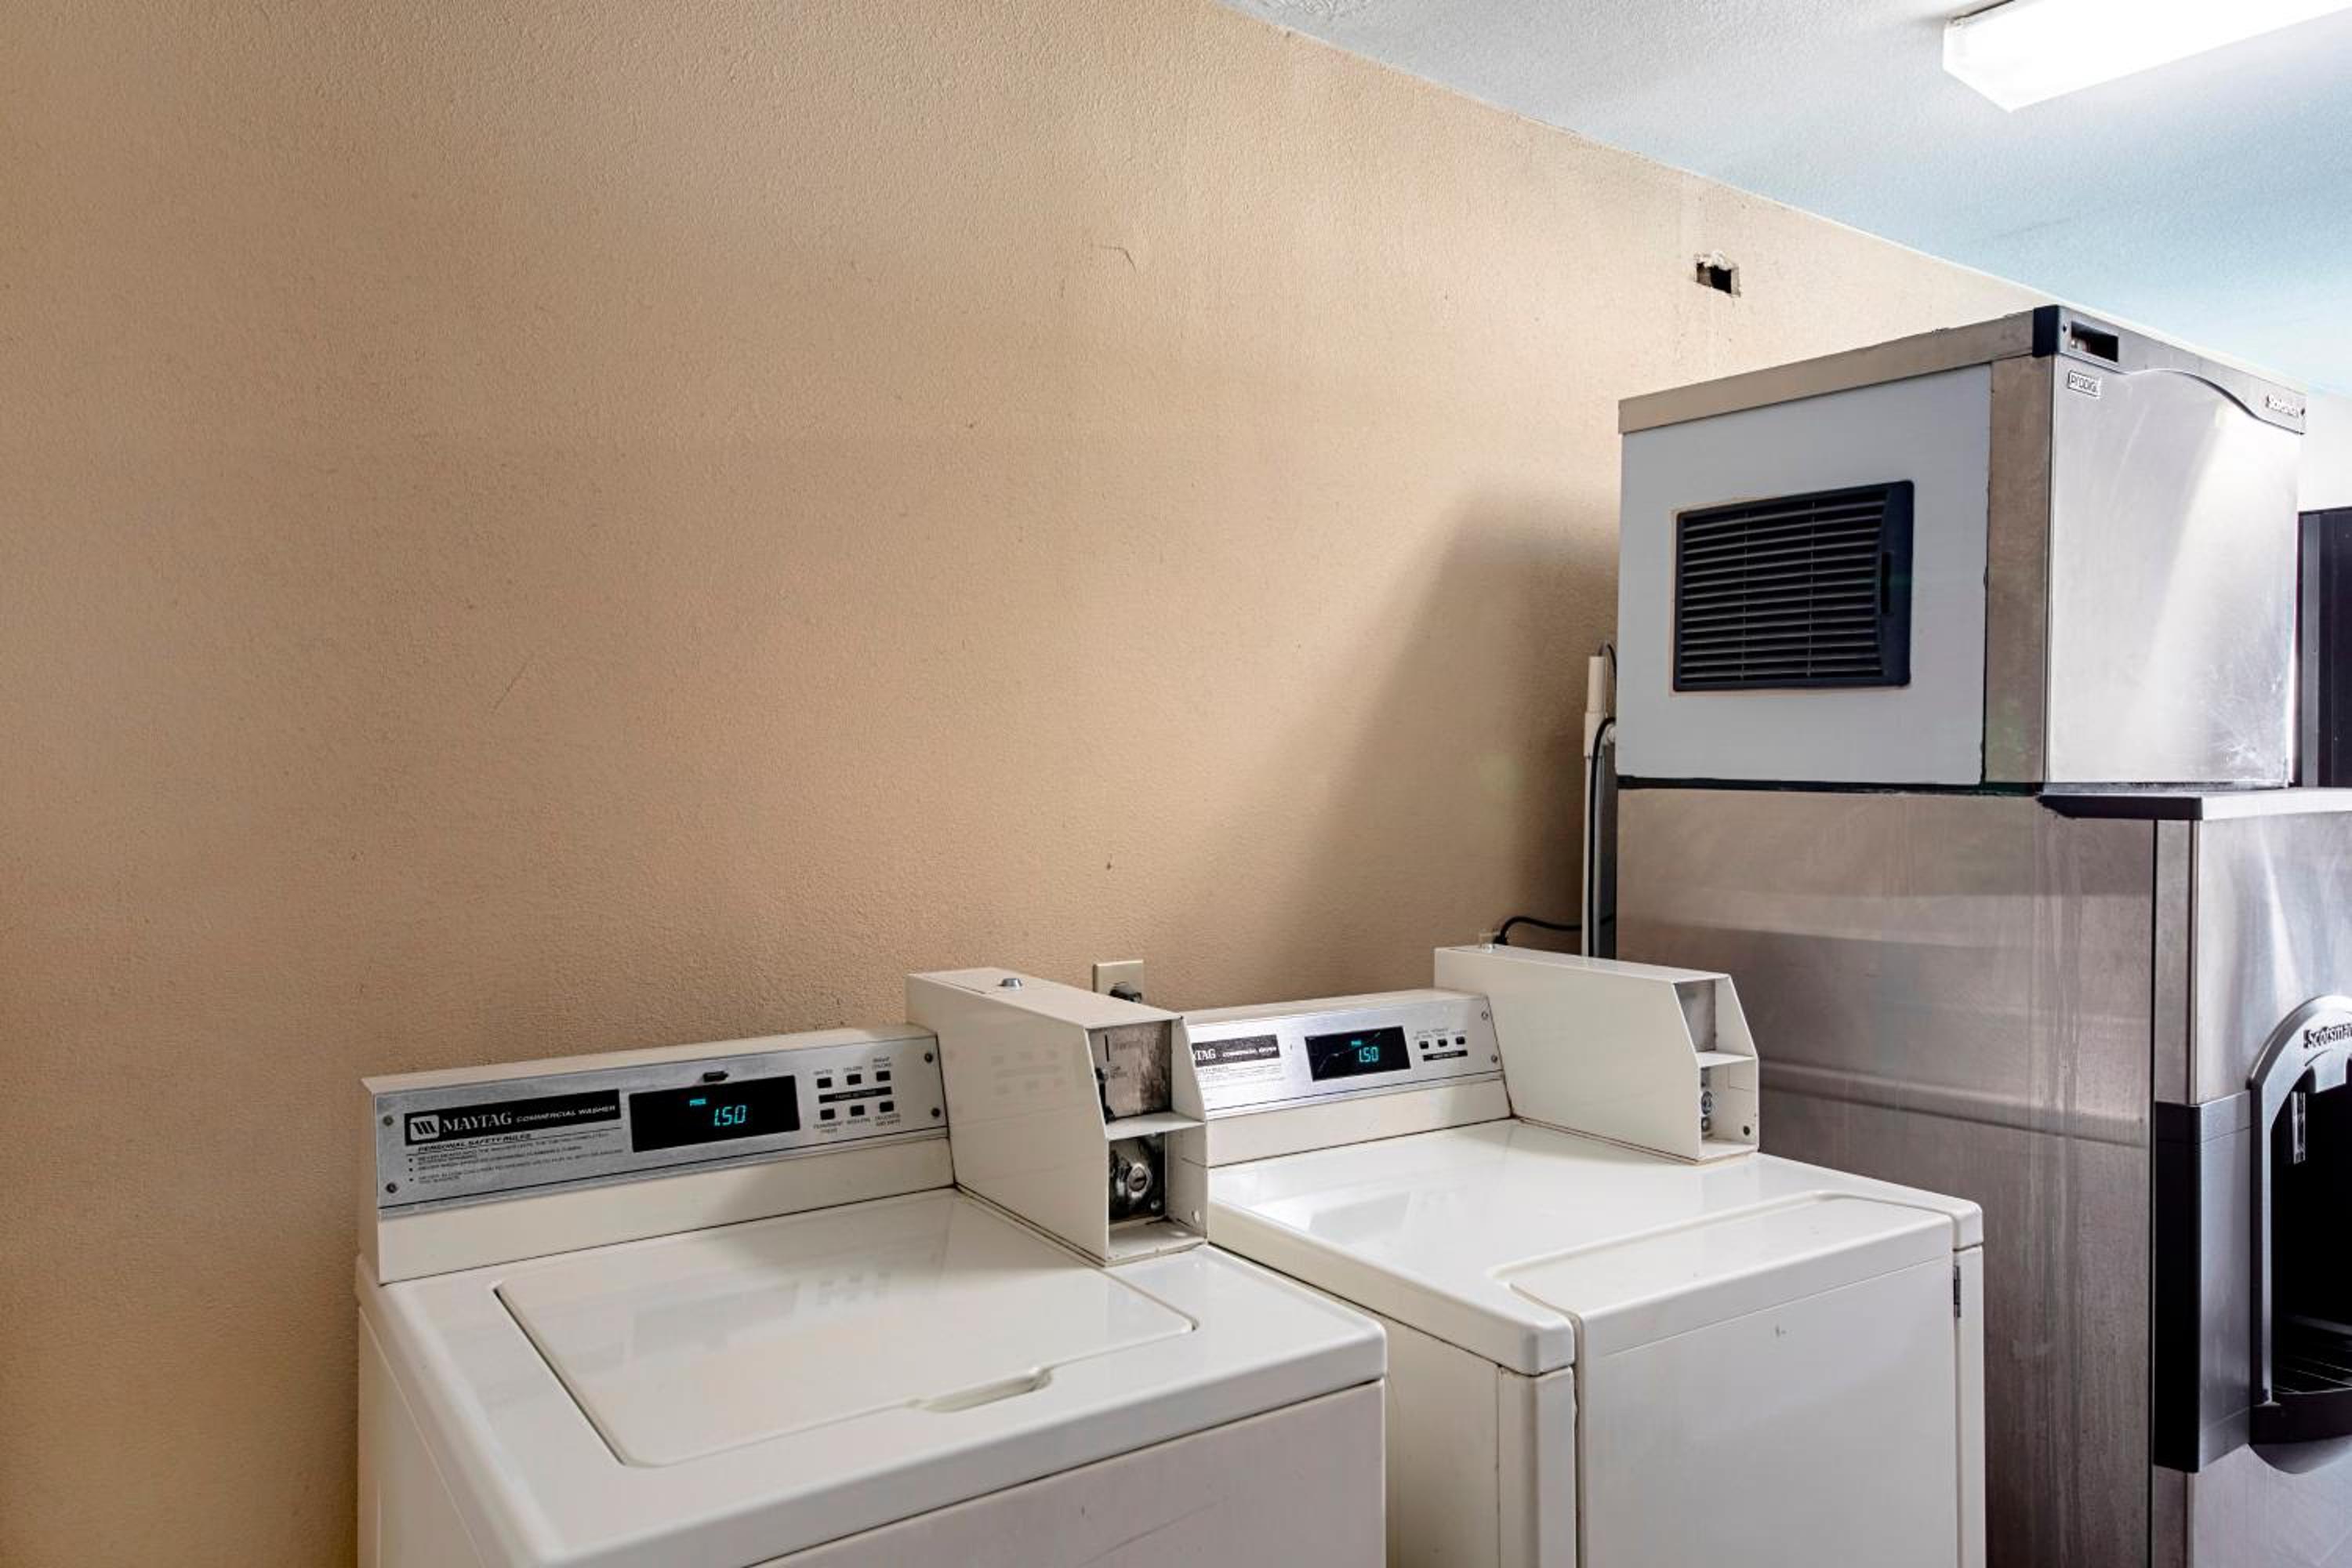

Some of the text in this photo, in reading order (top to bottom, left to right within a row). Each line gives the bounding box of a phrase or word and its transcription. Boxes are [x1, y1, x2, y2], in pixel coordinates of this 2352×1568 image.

[2303, 1023, 2352, 1049] Scotsma
[443, 1105, 615, 1133] MAYTAG COMMERCIAL WASHER
[714, 1105, 746, 1127] 1.50
